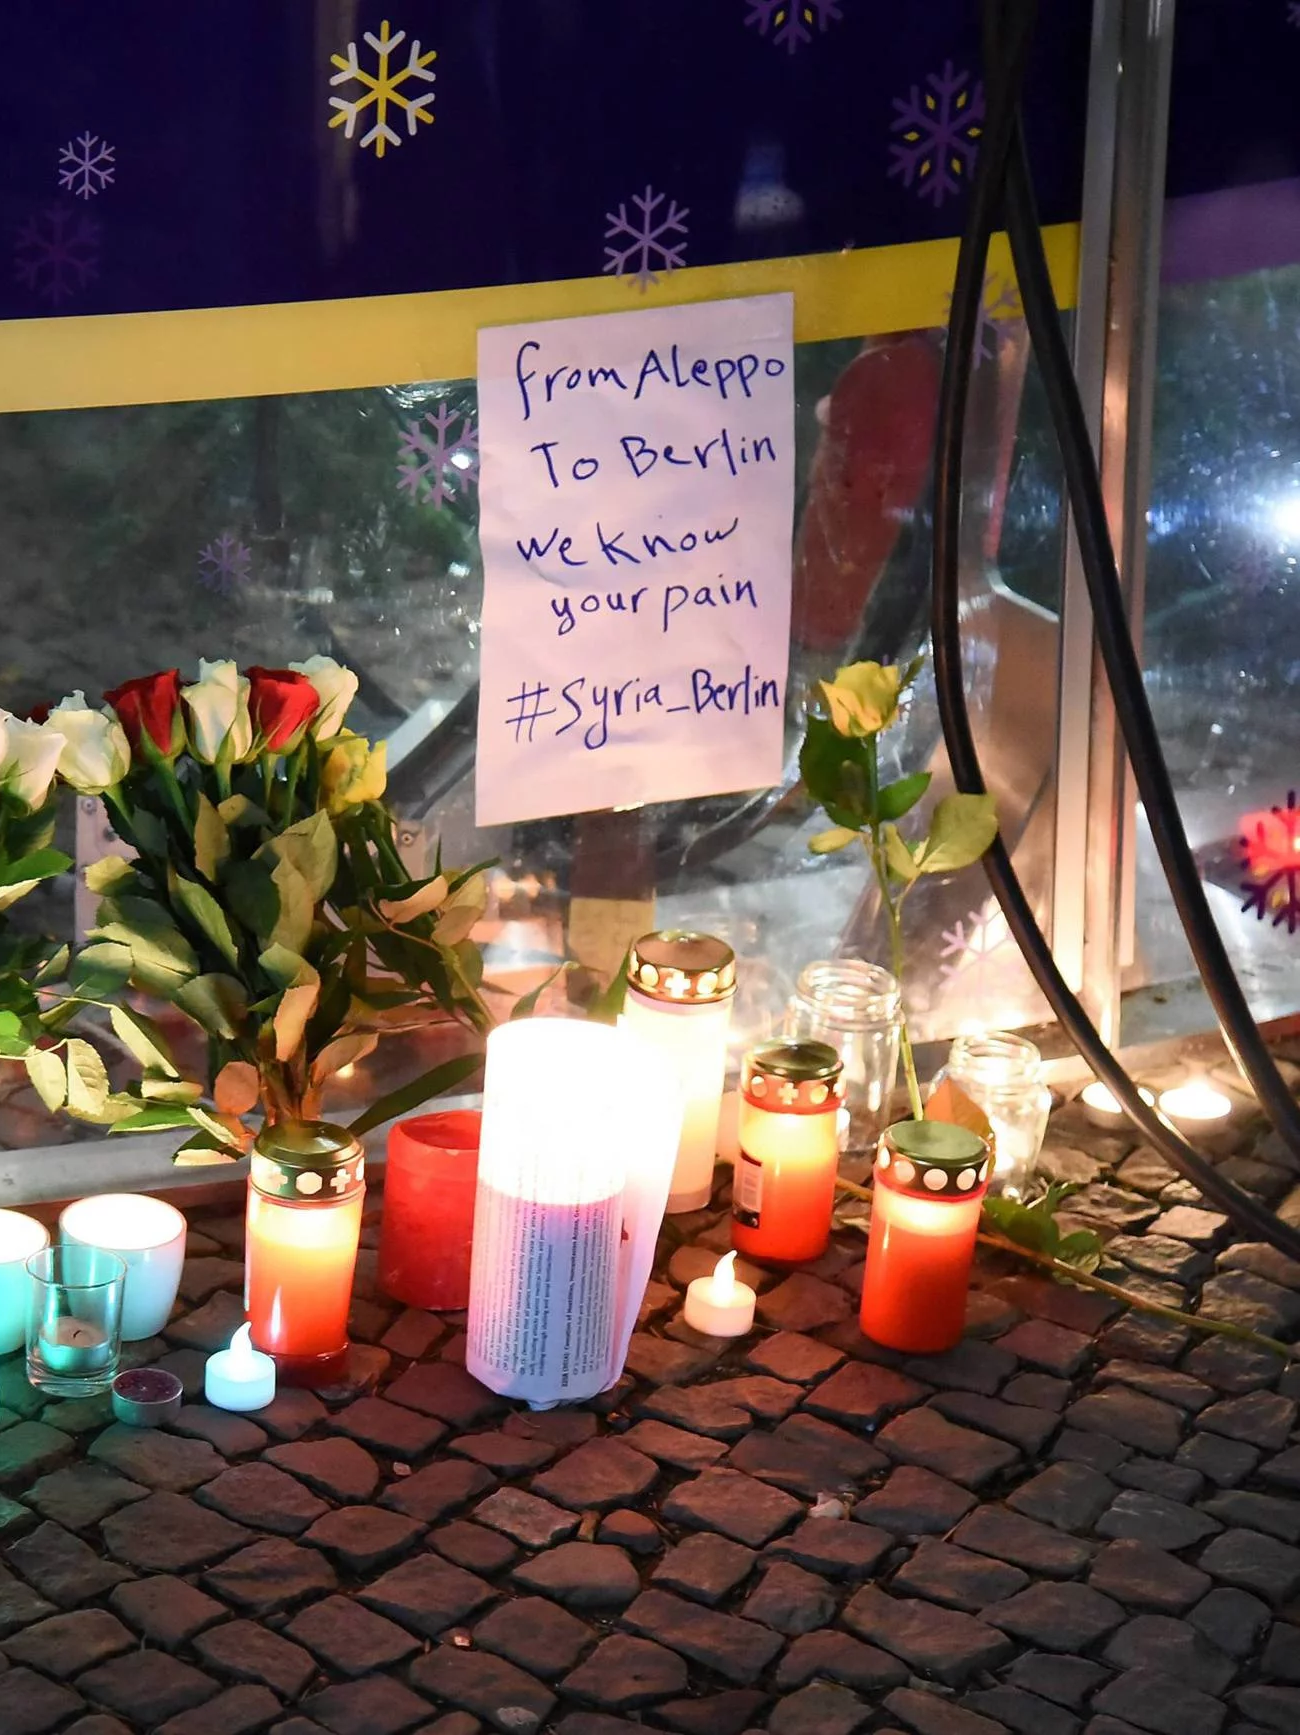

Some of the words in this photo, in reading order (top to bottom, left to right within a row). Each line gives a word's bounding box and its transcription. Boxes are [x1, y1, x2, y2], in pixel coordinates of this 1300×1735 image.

[633, 343, 786, 400] Aleppo
[529, 441, 599, 488] To
[619, 427, 777, 479] Berlin
[550, 584, 650, 637] your
[662, 573, 758, 633] pain
[504, 664, 780, 751] #Syria_Berlin
